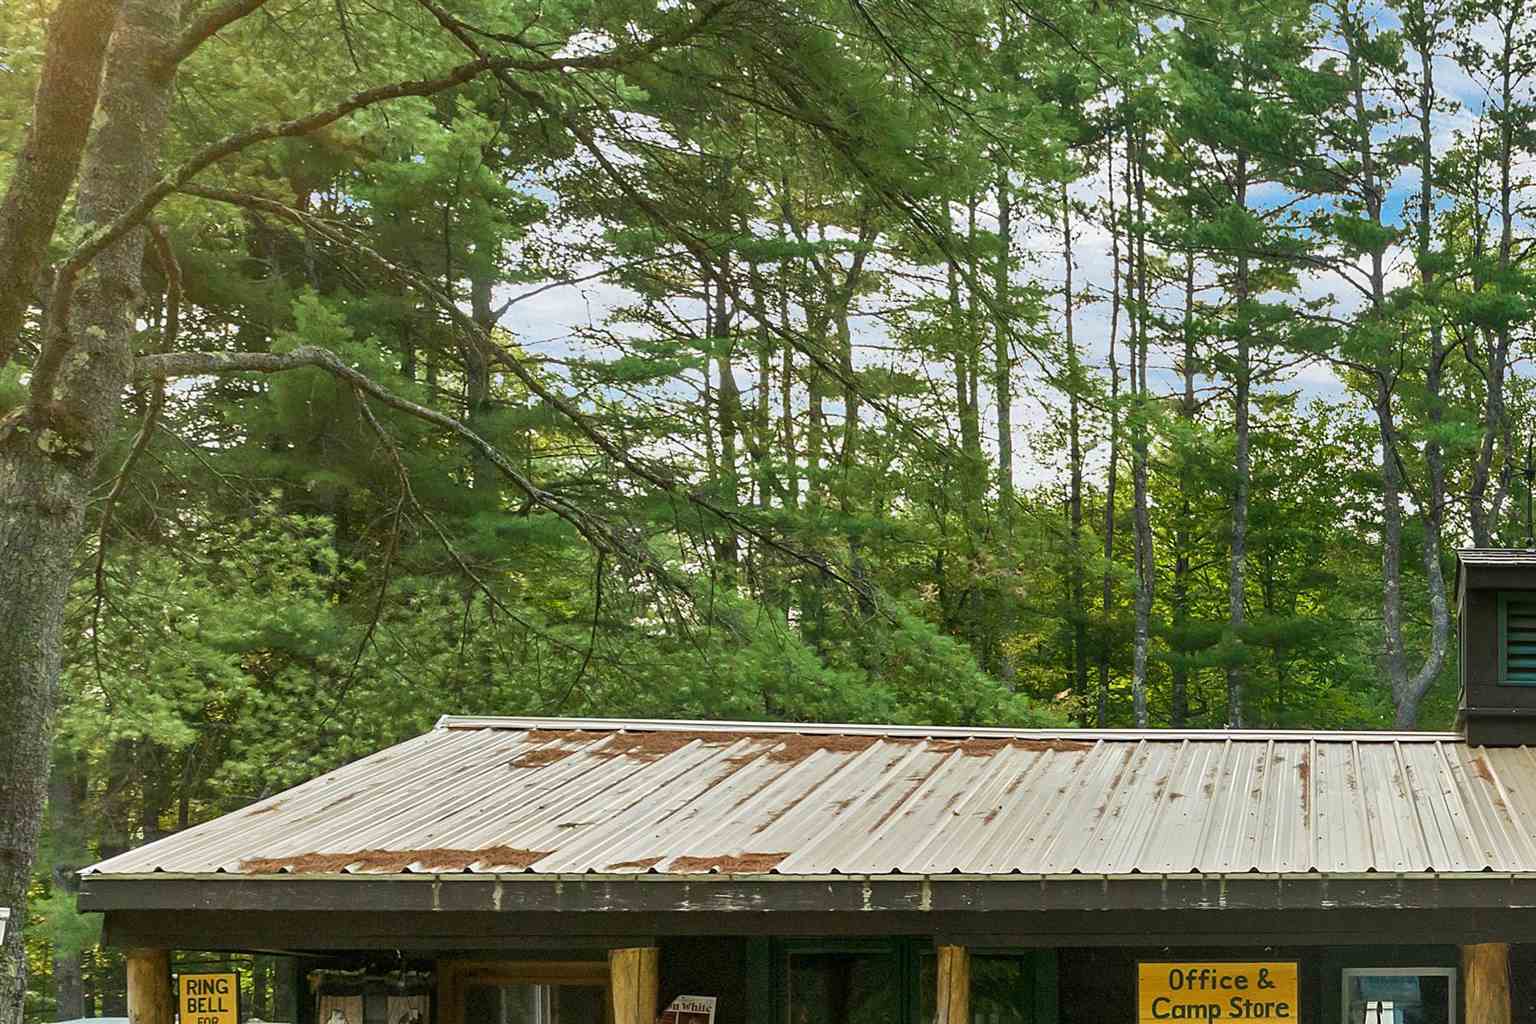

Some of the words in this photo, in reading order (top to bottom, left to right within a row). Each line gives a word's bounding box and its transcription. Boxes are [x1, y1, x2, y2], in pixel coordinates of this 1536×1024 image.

[186, 978, 229, 995] RING
[1168, 968, 1249, 990] Office
[1257, 967, 1276, 990] &
[187, 997, 229, 1013] BELL
[1228, 996, 1290, 1018] Store
